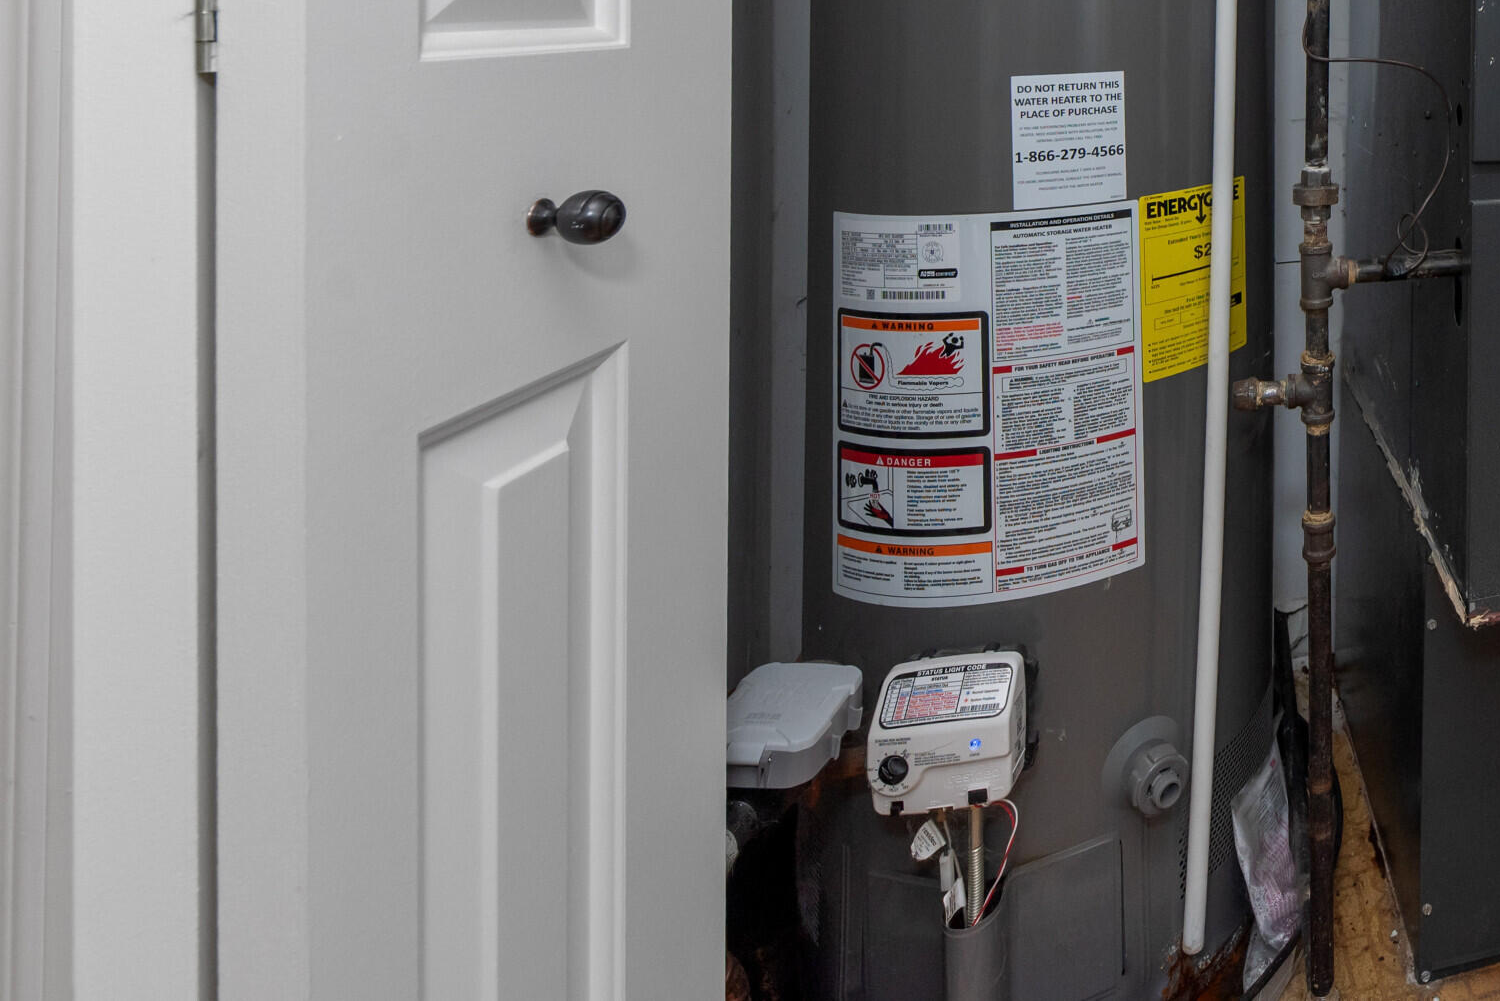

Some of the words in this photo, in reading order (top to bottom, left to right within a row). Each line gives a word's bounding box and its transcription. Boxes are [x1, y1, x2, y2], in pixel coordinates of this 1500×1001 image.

[1017, 85, 1032, 94] DO
[1035, 84, 1056, 93] NOT
[1058, 82, 1097, 92] RETURN
[1099, 80, 1120, 90] THIS
[1014, 97, 1049, 107] WATER
[1051, 94, 1088, 105] HEATER
[1089, 93, 1103, 103] TO
[1105, 92, 1123, 102] THE
[1020, 109, 1050, 119] PLACE
[1052, 108, 1067, 118] OF
[1068, 105, 1119, 117] PURCHASE
[1015, 144, 1124, 164] 1-866-279-4566
[1147, 185, 1239, 219] ENERGYGE
[1013, 231, 1046, 239] AUTOMATIC
[1047, 229, 1072, 237] STORAGE
[1073, 226, 1091, 234] WATER
[1092, 224, 1113, 232] HEATER
[1194, 243, 1212, 259] $2
[886, 457, 932, 467] DANGER
[887, 546, 934, 556] WARNING
[917, 668, 943, 677] STATUS
[944, 666, 965, 674] LIGHT
